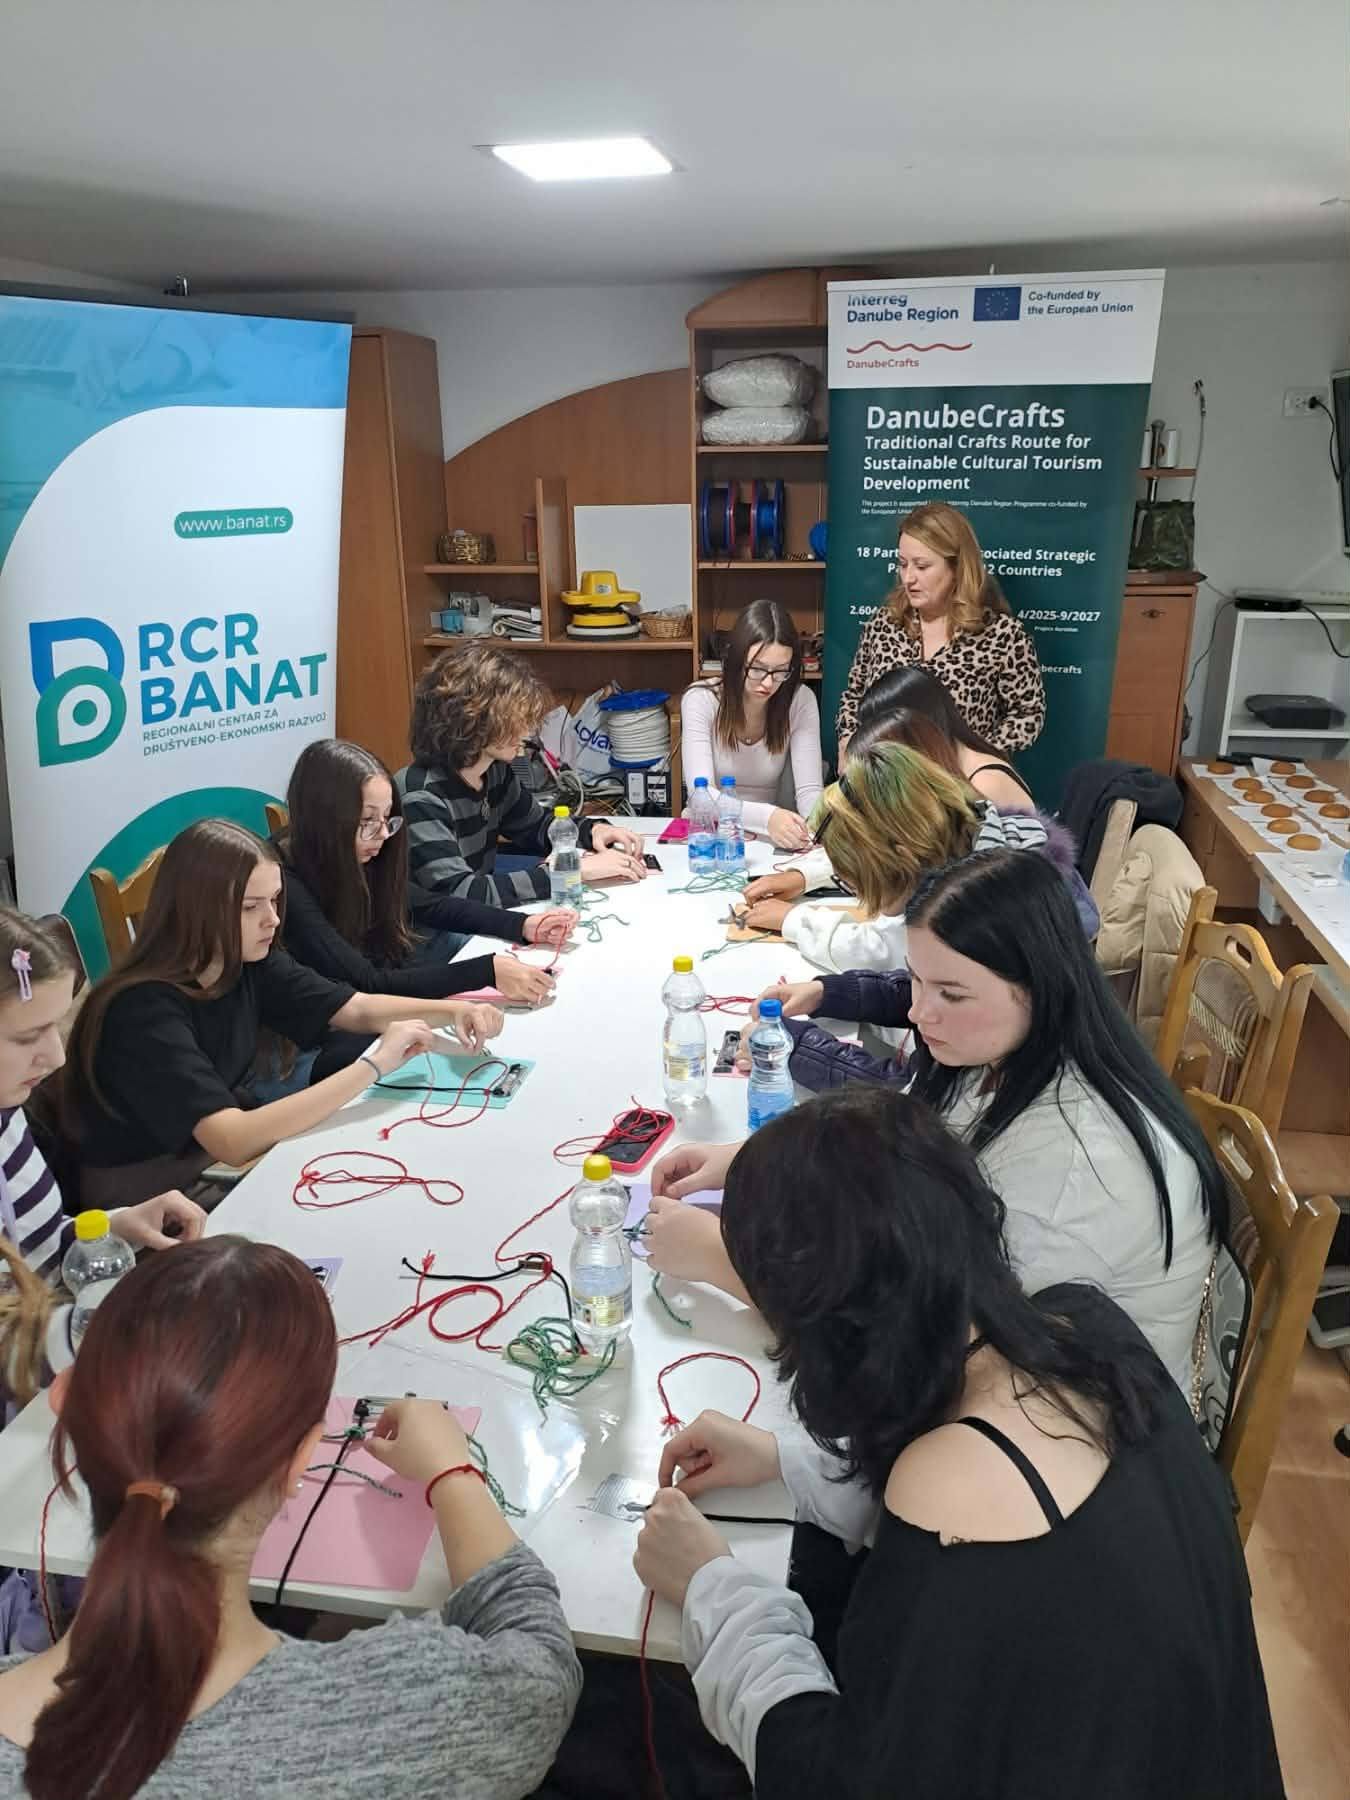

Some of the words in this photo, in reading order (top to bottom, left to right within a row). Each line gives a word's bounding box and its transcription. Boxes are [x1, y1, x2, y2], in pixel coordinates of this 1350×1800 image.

[847, 294, 908, 307] Interreg
[1028, 290, 1084, 301] Co-funded
[1086, 290, 1101, 300] by
[847, 309, 903, 322] Danube
[907, 307, 959, 322] Region
[1027, 306, 1044, 315] the
[1047, 304, 1098, 315] European
[1101, 303, 1134, 313] Union
[847, 358, 920, 369] DanubeCrafts
[866, 402, 1066, 430] DanubeCrafts
[865, 434, 953, 450] Traditional
[957, 434, 1007, 449] Crafts
[1011, 434, 1062, 449] Route
[1066, 433, 1092, 449] for
[863, 456, 958, 471] Sustainable
[962, 455, 1028, 470] Cultural
[1032, 455, 1103, 470] Tourism
[863, 476, 971, 493] Development
[179, 514, 287, 533] www.banat.rs
[857, 547, 870, 558] 18
[874, 547, 900, 558] Part
[1036, 550, 1096, 564] Strategic
[998, 565, 1062, 576] Countries
[1018, 610, 1101, 622] 4/2025-9/2027
[139, 613, 258, 671] RCR
[1040, 664, 1082, 674] becrafts
[140, 653, 327, 725] BANAT
[143, 720, 216, 741] REGIONALNI
[218, 712, 261, 727] CENTAR
[264, 709, 279, 718] ZA
[143, 722, 286, 756] DRUŠTVENO-EKONOMSKI
[288, 712, 327, 728] RAZVOJ
